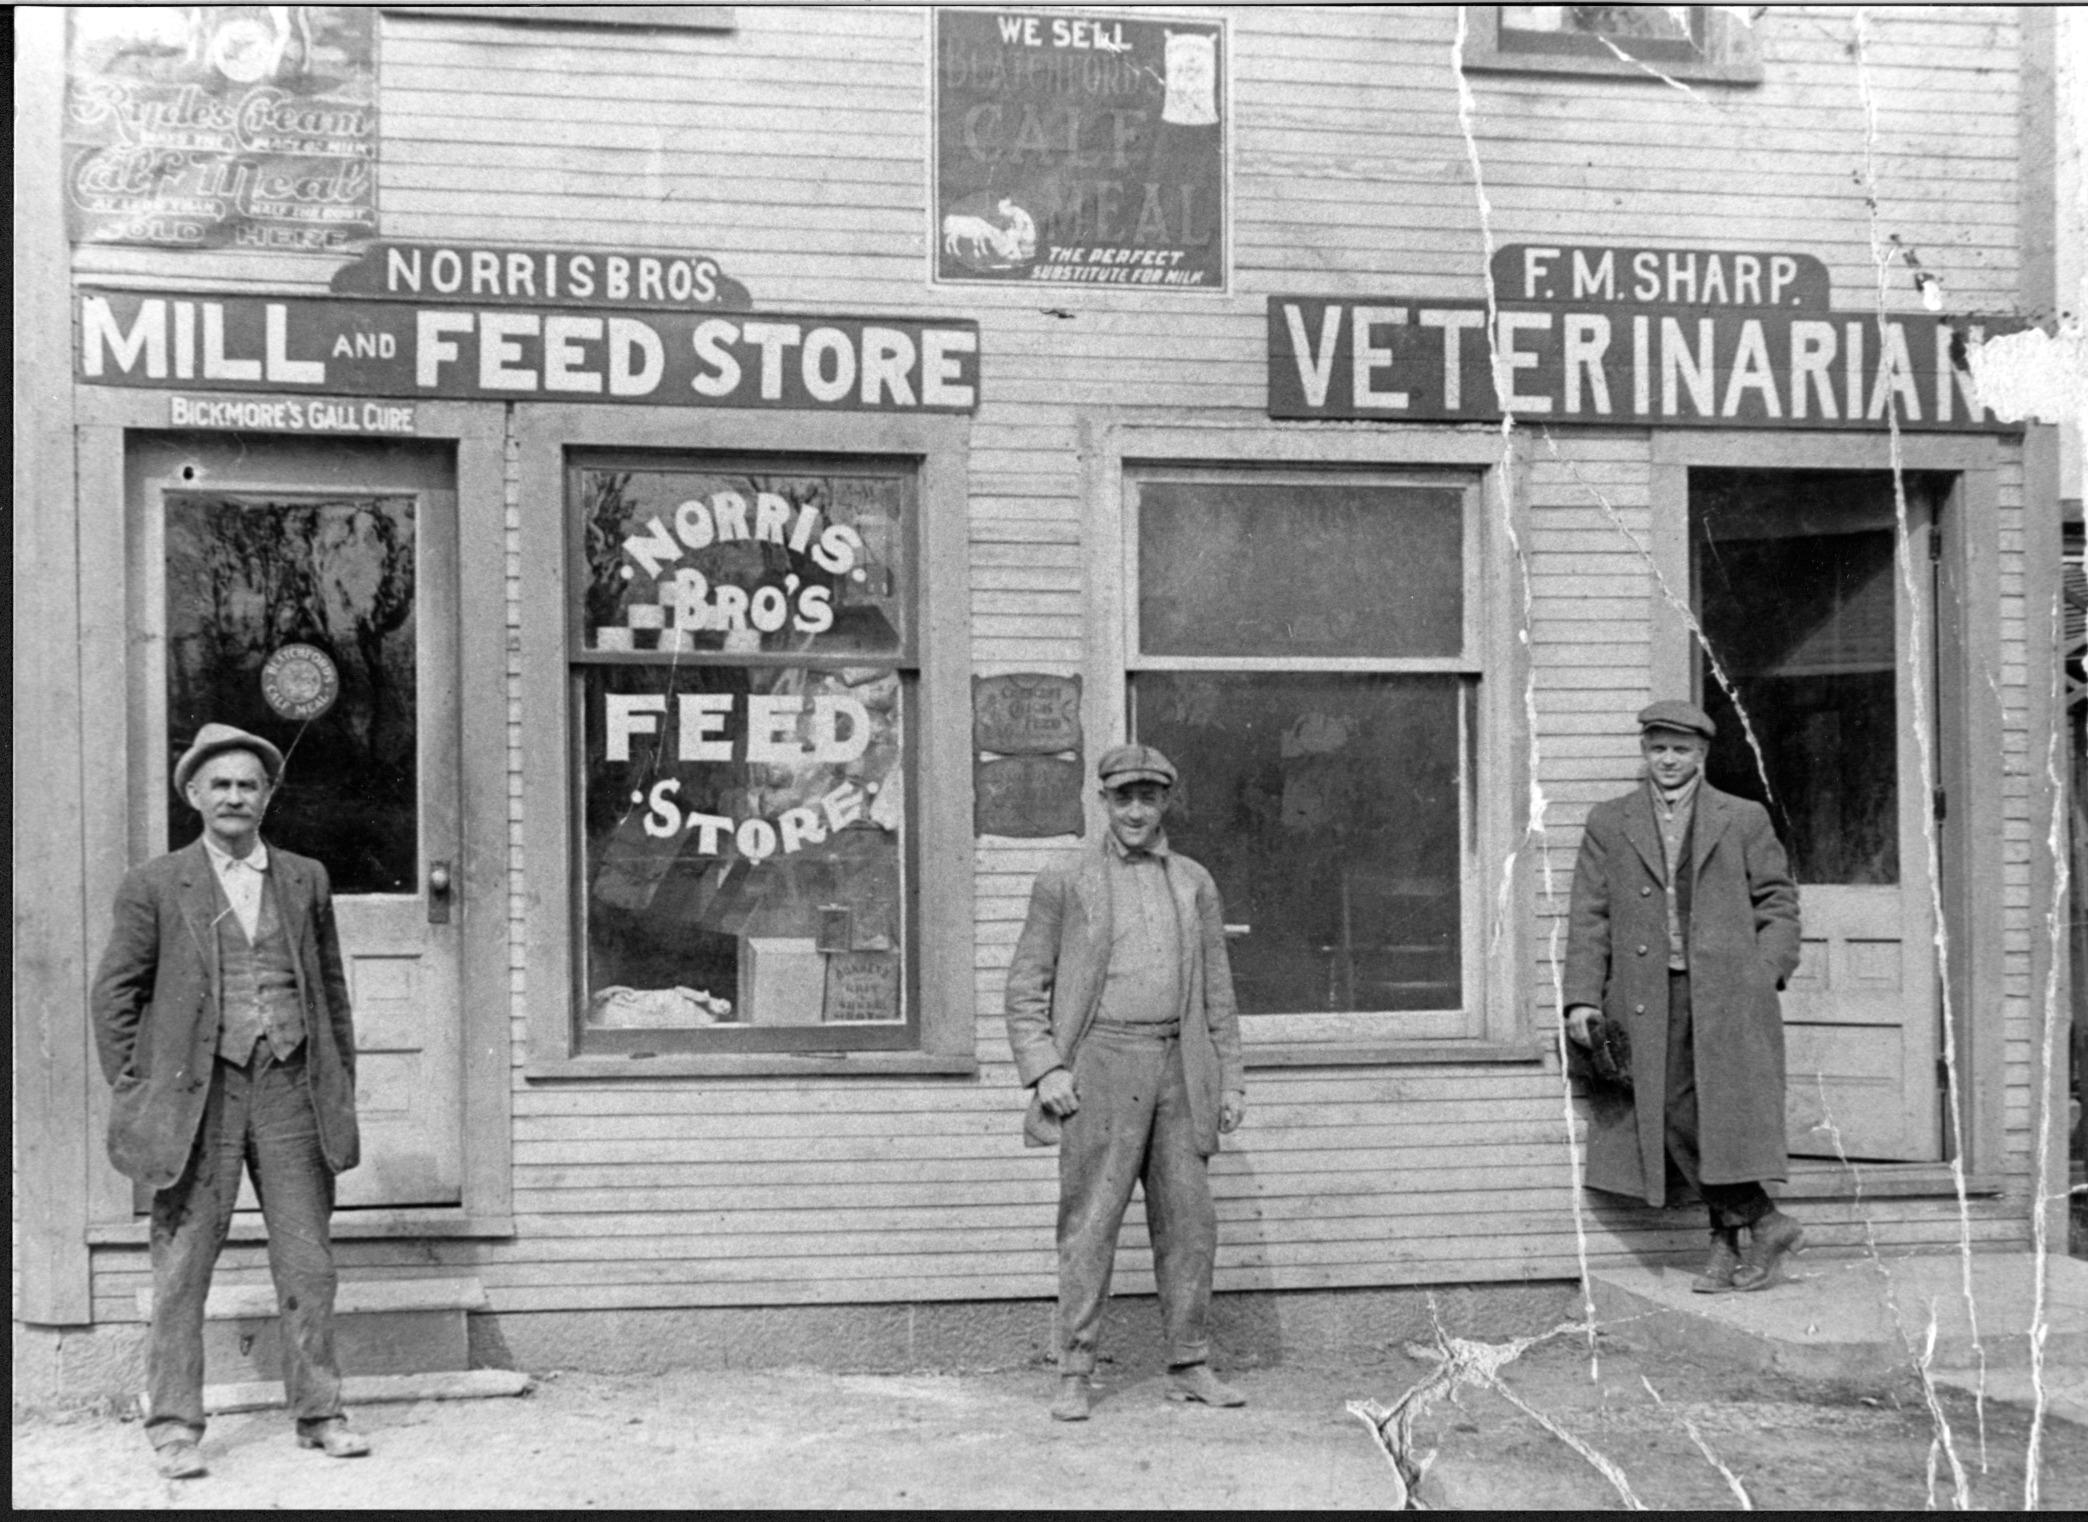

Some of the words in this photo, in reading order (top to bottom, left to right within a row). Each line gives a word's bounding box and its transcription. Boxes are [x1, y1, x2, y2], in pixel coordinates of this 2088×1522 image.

[998, 16, 1042, 46] WE
[1052, 19, 1133, 51] SELL
[964, 102, 1148, 169] CALF
[236, 225, 347, 247] HERE
[1044, 176, 1211, 247] MEAL
[387, 247, 595, 298] NORRIS
[1031, 265, 1130, 282] SUBSTITUTE
[1131, 268, 1164, 284] FOR
[1165, 270, 1205, 285] MILK
[1048, 246, 1085, 263] THE
[1088, 247, 1185, 266] PERFECT
[83, 296, 325, 383] MILL
[332, 333, 396, 359] AND
[416, 310, 665, 397] FEED
[691, 319, 977, 407] STORE
[1283, 303, 1985, 424] VETERINARIAN
[171, 397, 304, 429] BICKMORE'S
[308, 401, 359, 430] GALL
[363, 404, 415, 432] CURE
[605, 693, 871, 763] FEED
